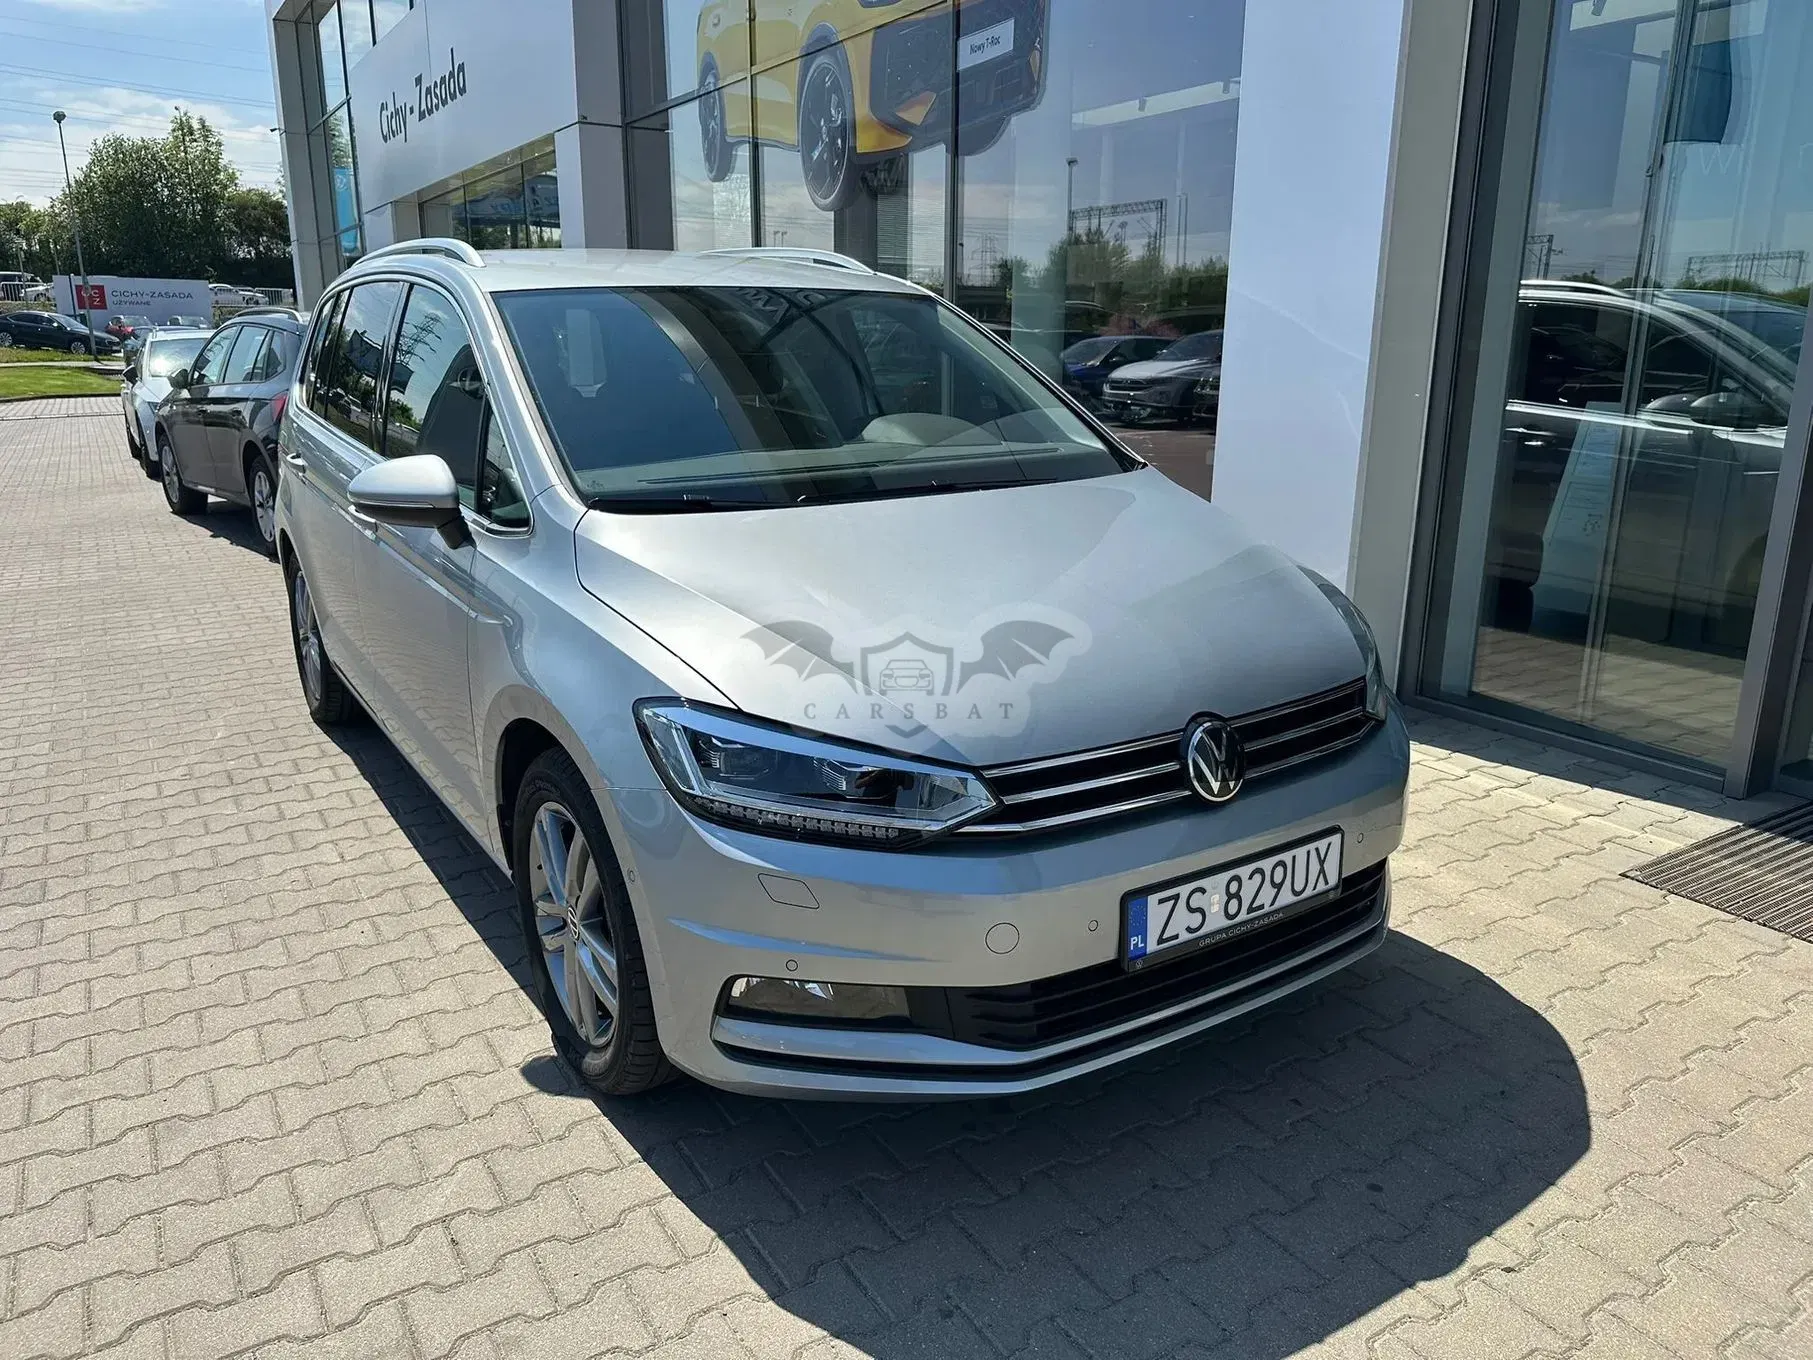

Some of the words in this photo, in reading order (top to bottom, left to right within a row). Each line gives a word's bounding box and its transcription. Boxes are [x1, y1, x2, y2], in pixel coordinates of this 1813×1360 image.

[969, 42, 986, 55] Nowy
[379, 91, 407, 144] Cichy
[414, 46, 467, 122] Zasada
[111, 289, 194, 300] CICHY-ZASADA
[1156, 886, 1208, 946] ZS
[1223, 841, 1333, 921] 829UX
[1130, 934, 1145, 951] PL
[1199, 932, 1227, 948] GRUPA
[1228, 911, 1285, 937] CICHY-ZASADA
